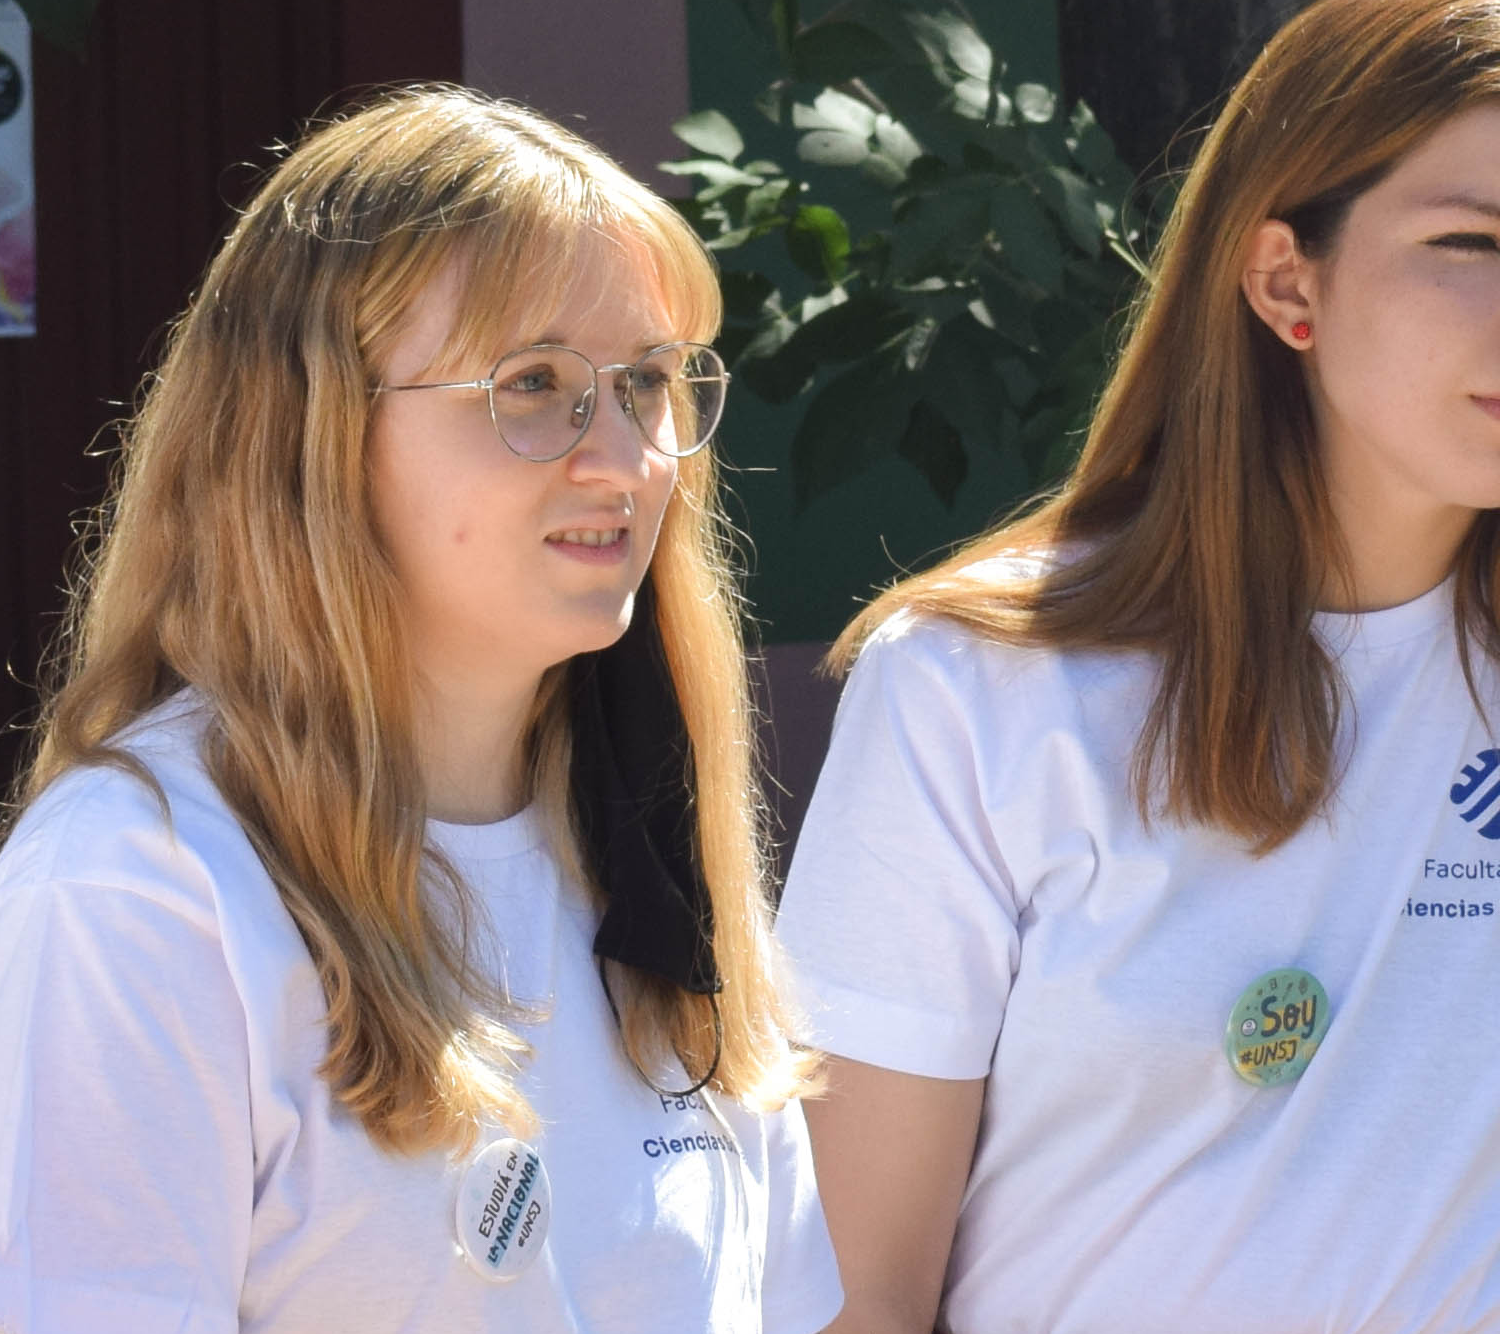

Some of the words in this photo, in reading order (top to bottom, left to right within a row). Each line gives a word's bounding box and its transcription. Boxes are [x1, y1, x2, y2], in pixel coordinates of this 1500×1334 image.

[1401, 897, 1494, 918] iencias
[1260, 995, 1317, 1039] Soy
[1240, 1039, 1297, 1066] #UNSJ
[506, 1151, 518, 1171] EN
[496, 1153, 539, 1250] NACIONAL
